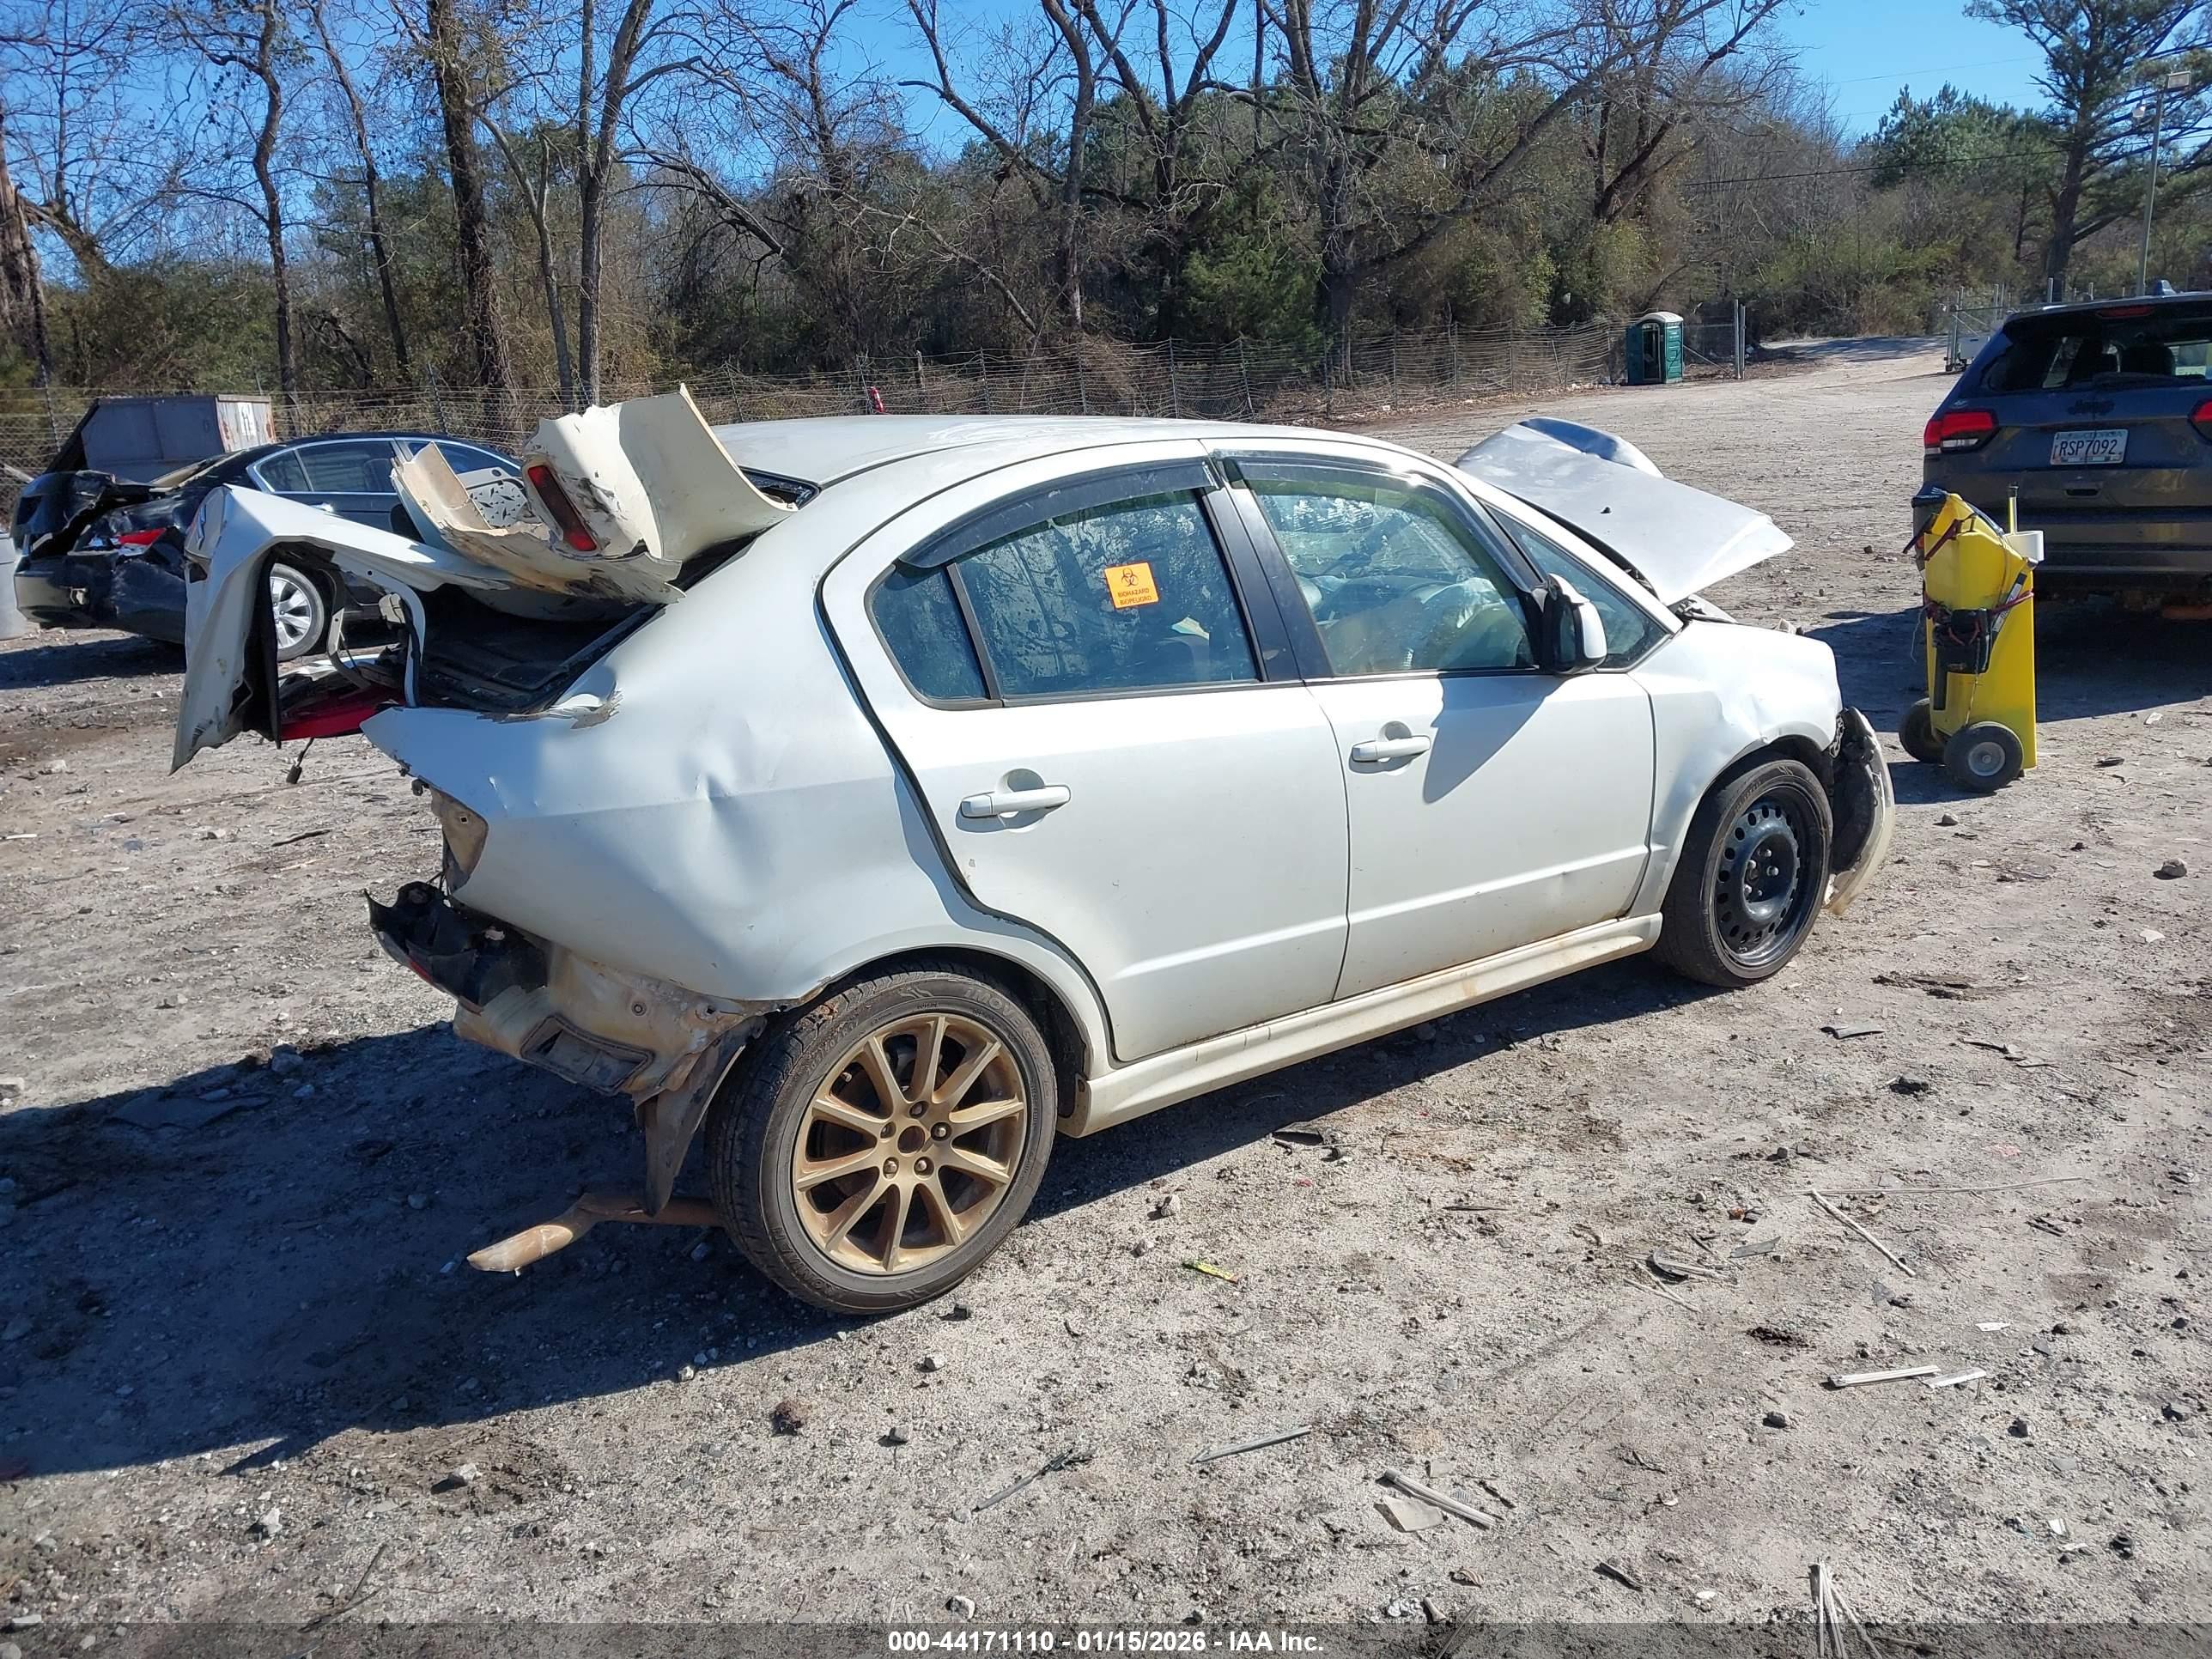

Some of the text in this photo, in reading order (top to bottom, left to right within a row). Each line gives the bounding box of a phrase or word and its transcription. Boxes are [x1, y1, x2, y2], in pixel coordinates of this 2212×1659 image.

[2059, 439, 2118, 456] RSP7092
[1117, 588, 1150, 599] BIOHAZARD
[1120, 595, 1152, 605] BIOPELIGRO
